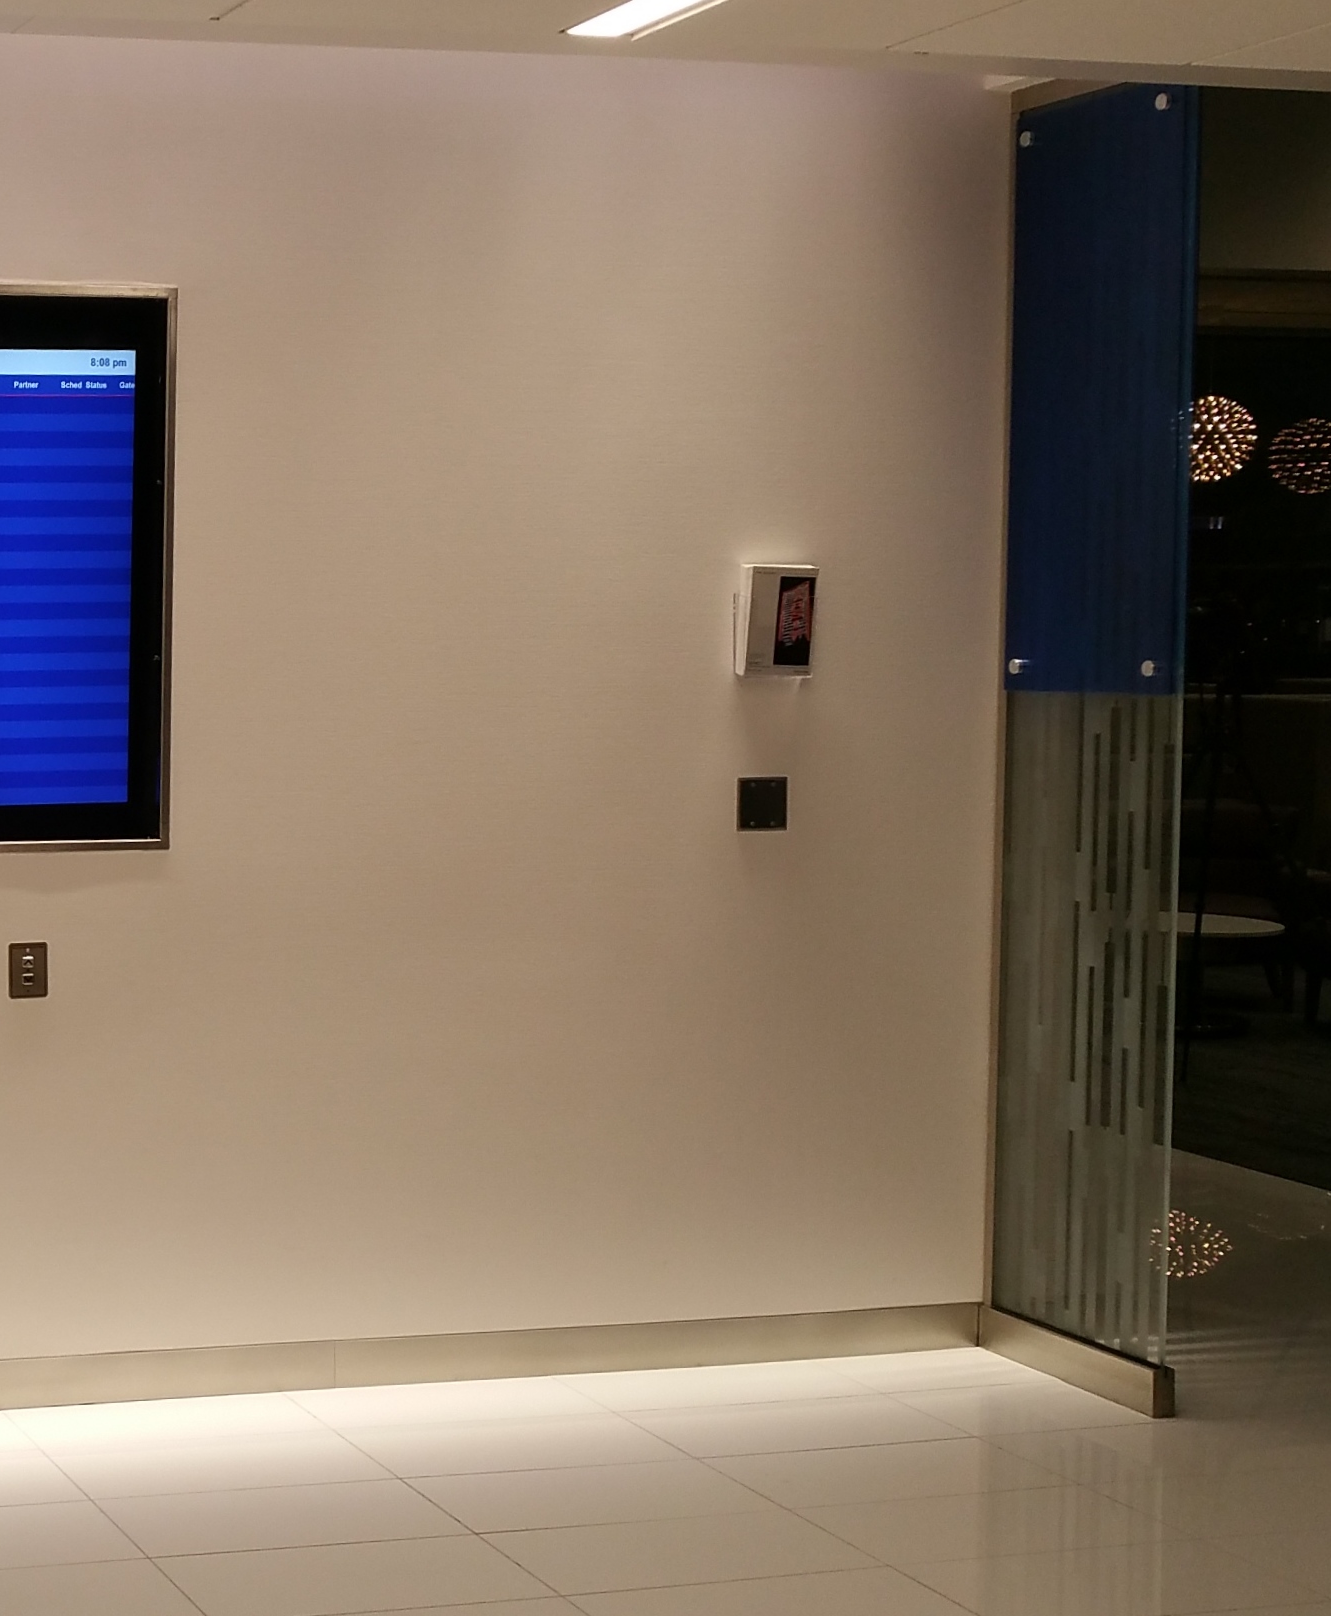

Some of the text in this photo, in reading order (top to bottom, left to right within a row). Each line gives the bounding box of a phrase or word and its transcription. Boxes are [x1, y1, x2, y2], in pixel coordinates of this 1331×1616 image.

[90, 357, 127, 369] 8:08 pm
[14, 381, 39, 389] Partner
[61, 381, 82, 389] Sched
[85, 381, 107, 389] Status
[119, 381, 135, 389] Gate
